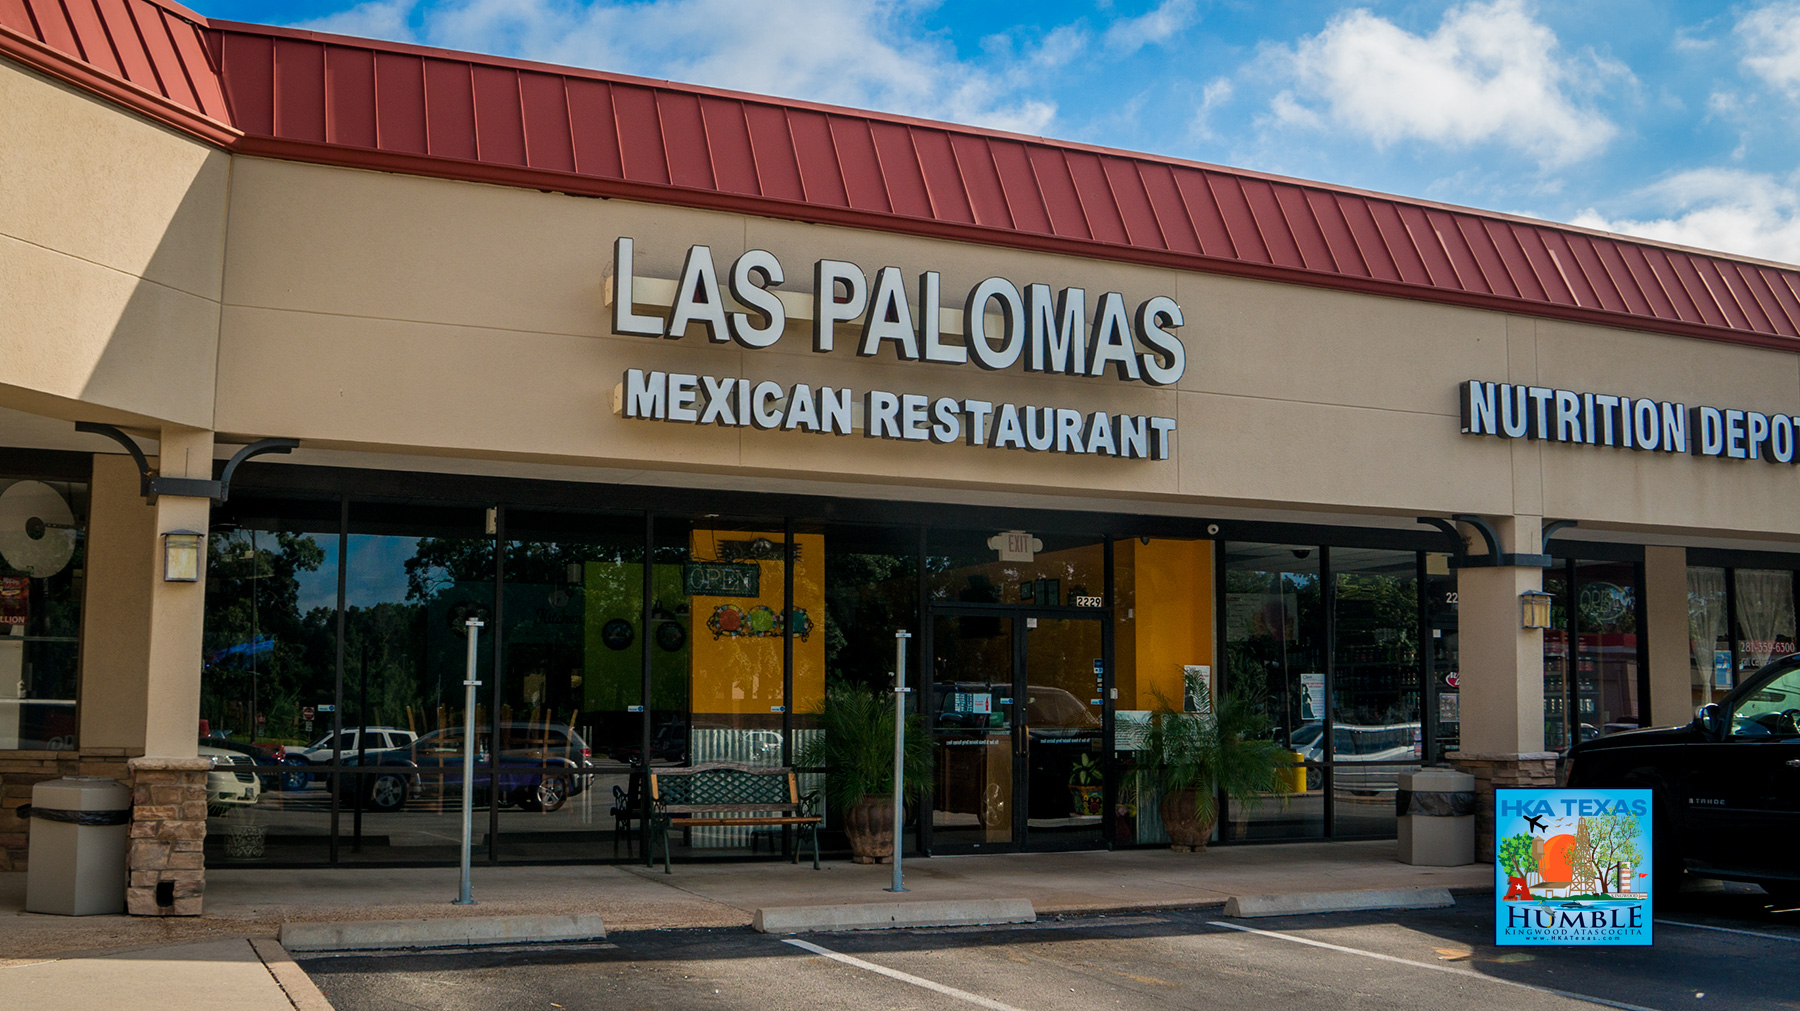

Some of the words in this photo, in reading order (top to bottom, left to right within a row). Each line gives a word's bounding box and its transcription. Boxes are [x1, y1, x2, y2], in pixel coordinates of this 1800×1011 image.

[612, 237, 785, 349] LAS
[812, 258, 1186, 386] PALOMAS
[622, 368, 852, 436] MEXICAN
[864, 390, 1177, 460] RESTAURANT
[1460, 379, 1686, 453] NUTRITION
[1009, 534, 1030, 553] EXIT
[690, 568, 753, 591] OPEN
[1077, 597, 1101, 607] 2229
[1740, 641, 1795, 653] 281-359-6300
[1695, 797, 1726, 806] TAHOE
